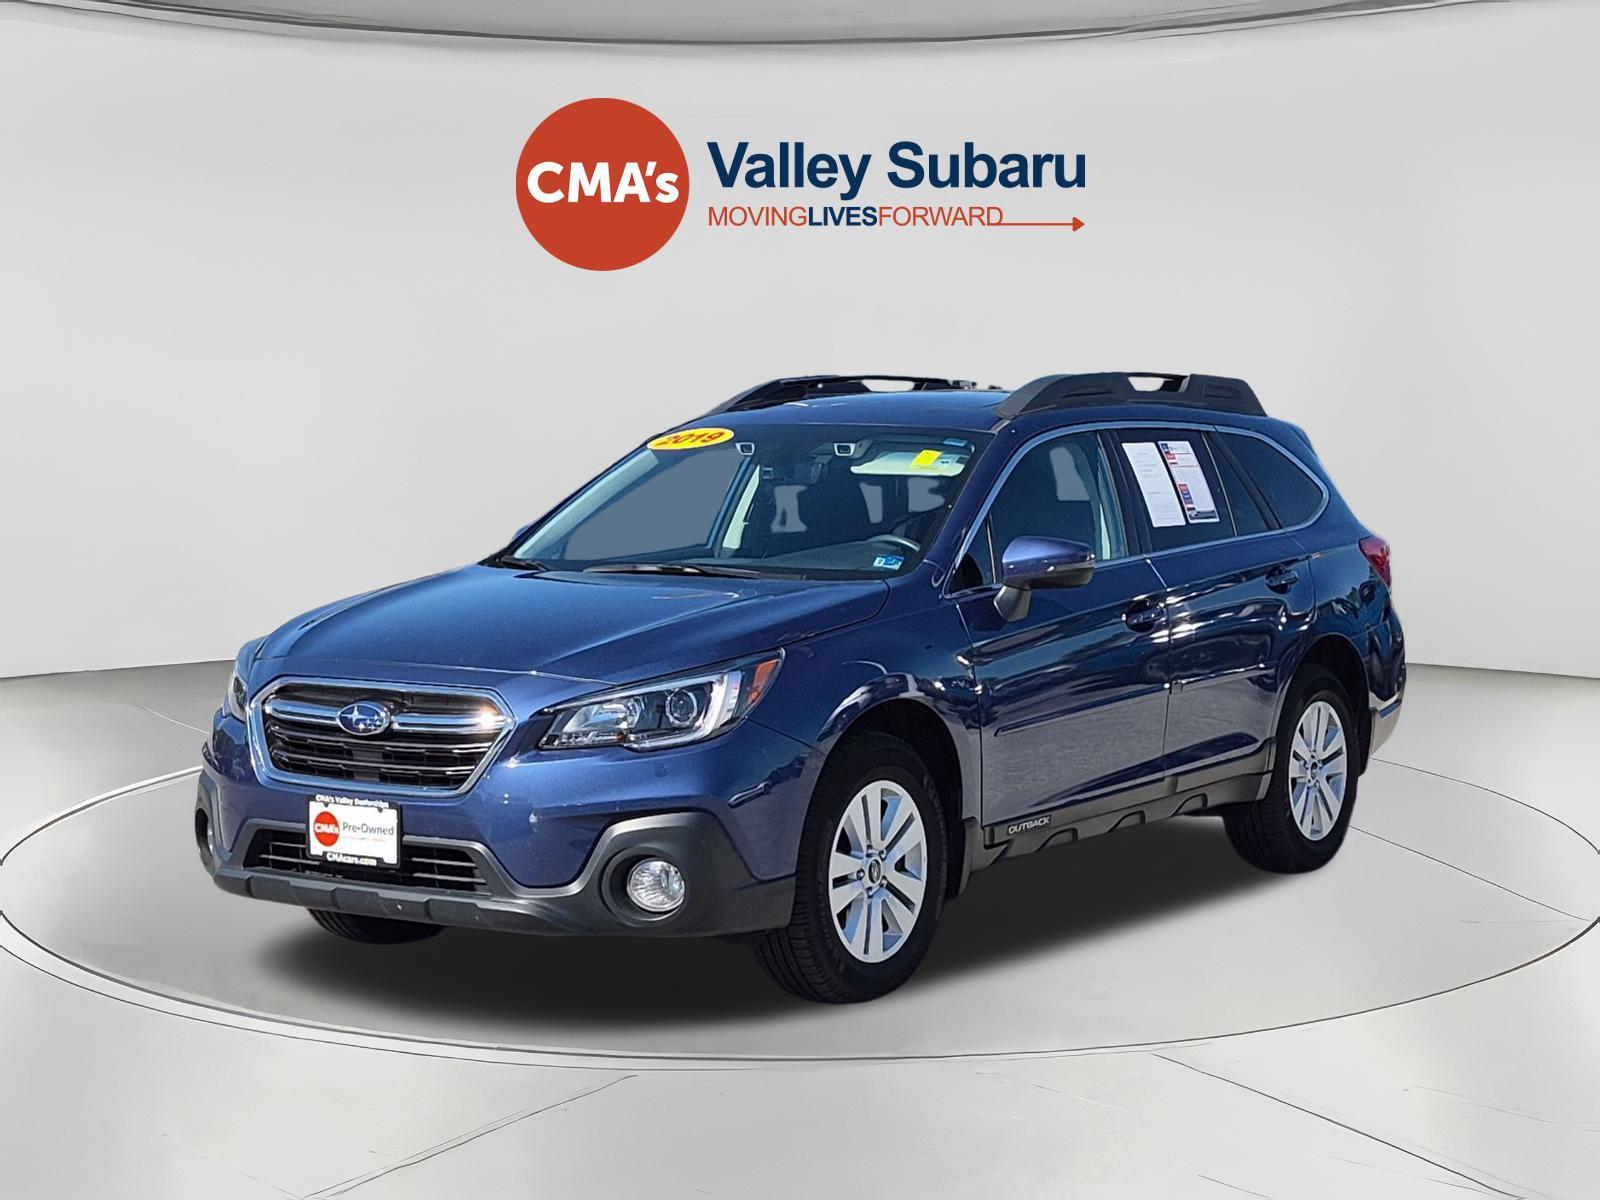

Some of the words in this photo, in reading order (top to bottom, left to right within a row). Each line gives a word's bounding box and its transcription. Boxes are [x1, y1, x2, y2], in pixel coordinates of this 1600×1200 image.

[655, 431, 725, 446] 2019
[342, 821, 395, 836] Pre-Owned
[1008, 816, 1050, 835] OUTBACK
